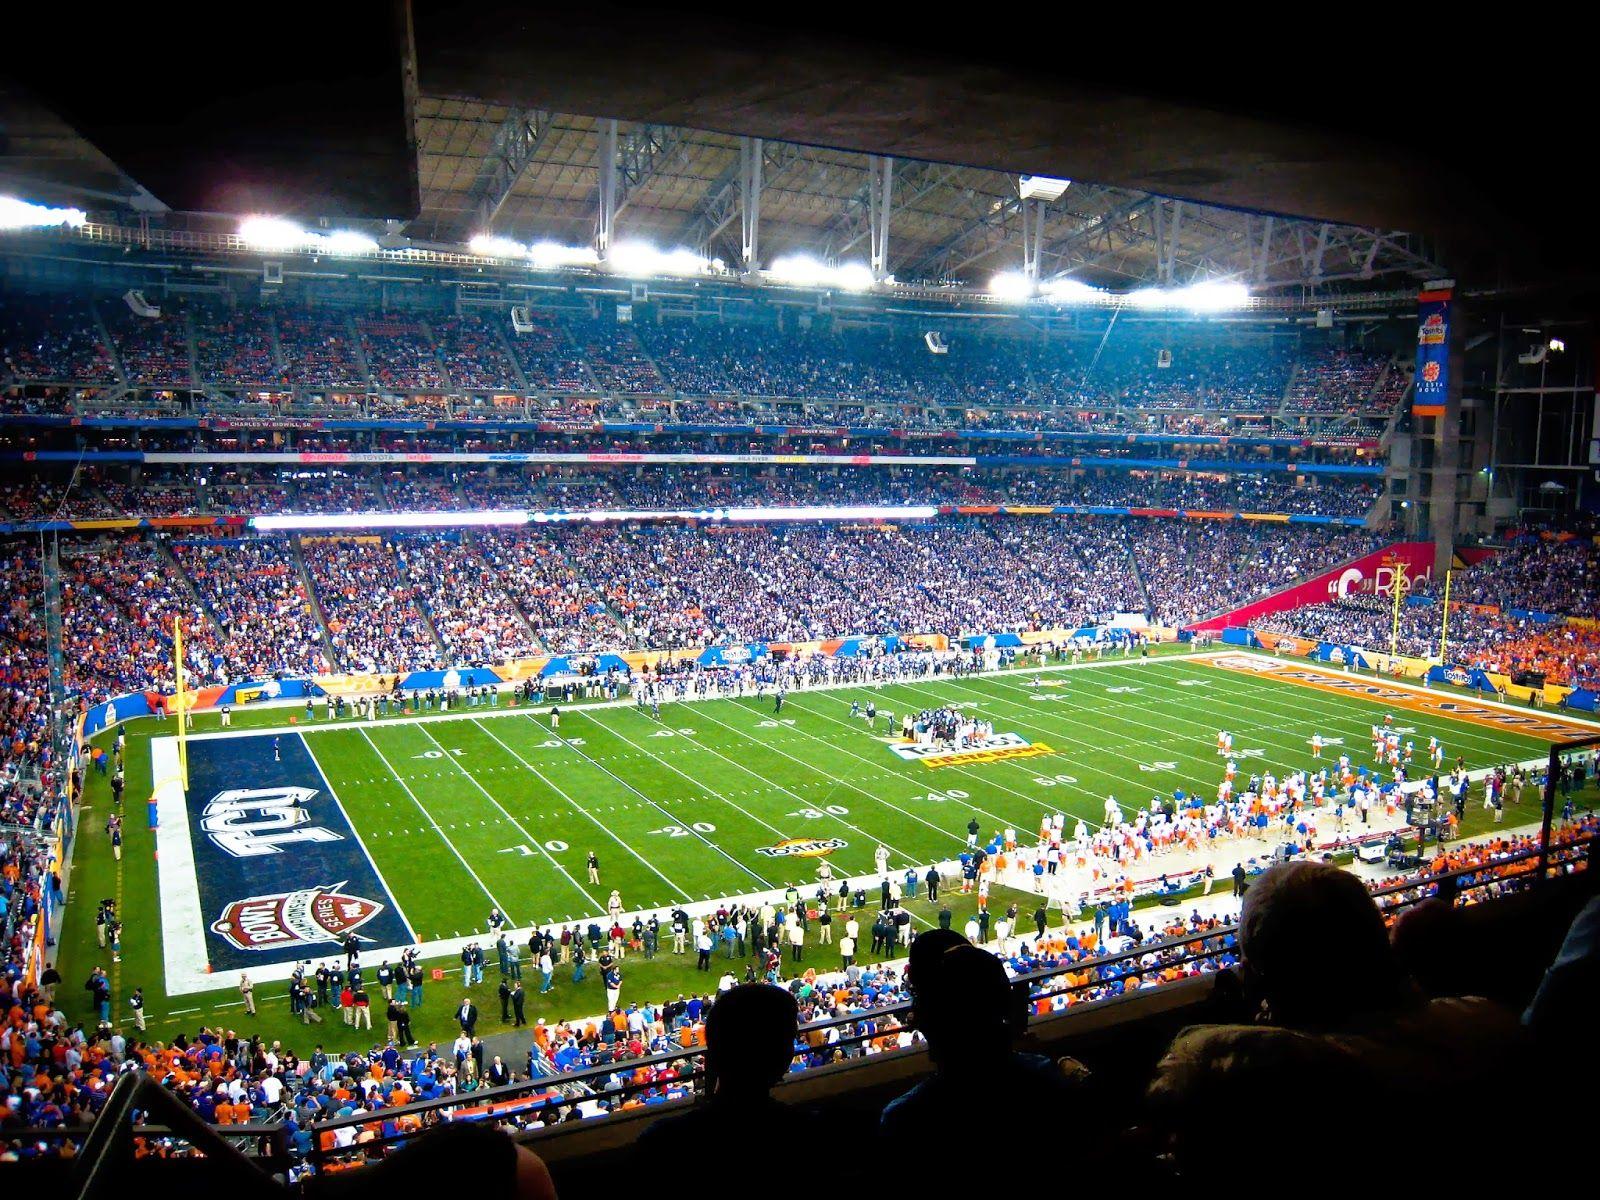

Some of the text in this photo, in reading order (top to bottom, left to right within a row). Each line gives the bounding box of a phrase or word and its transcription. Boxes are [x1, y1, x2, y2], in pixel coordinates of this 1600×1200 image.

[543, 737, 587, 748] 20
[423, 748, 468, 758] 10
[927, 751, 991, 765] FIESTA
[992, 745, 1046, 758] BOWL
[1032, 774, 1078, 786] 50
[927, 789, 970, 801] 40
[798, 805, 850, 818] 30
[200, 786, 345, 858] TCU
[662, 822, 716, 837] 20
[513, 840, 570, 856] 10
[317, 898, 344, 929] SERIES
[341, 901, 365, 919] FOX
[239, 900, 292, 942] BOWL
